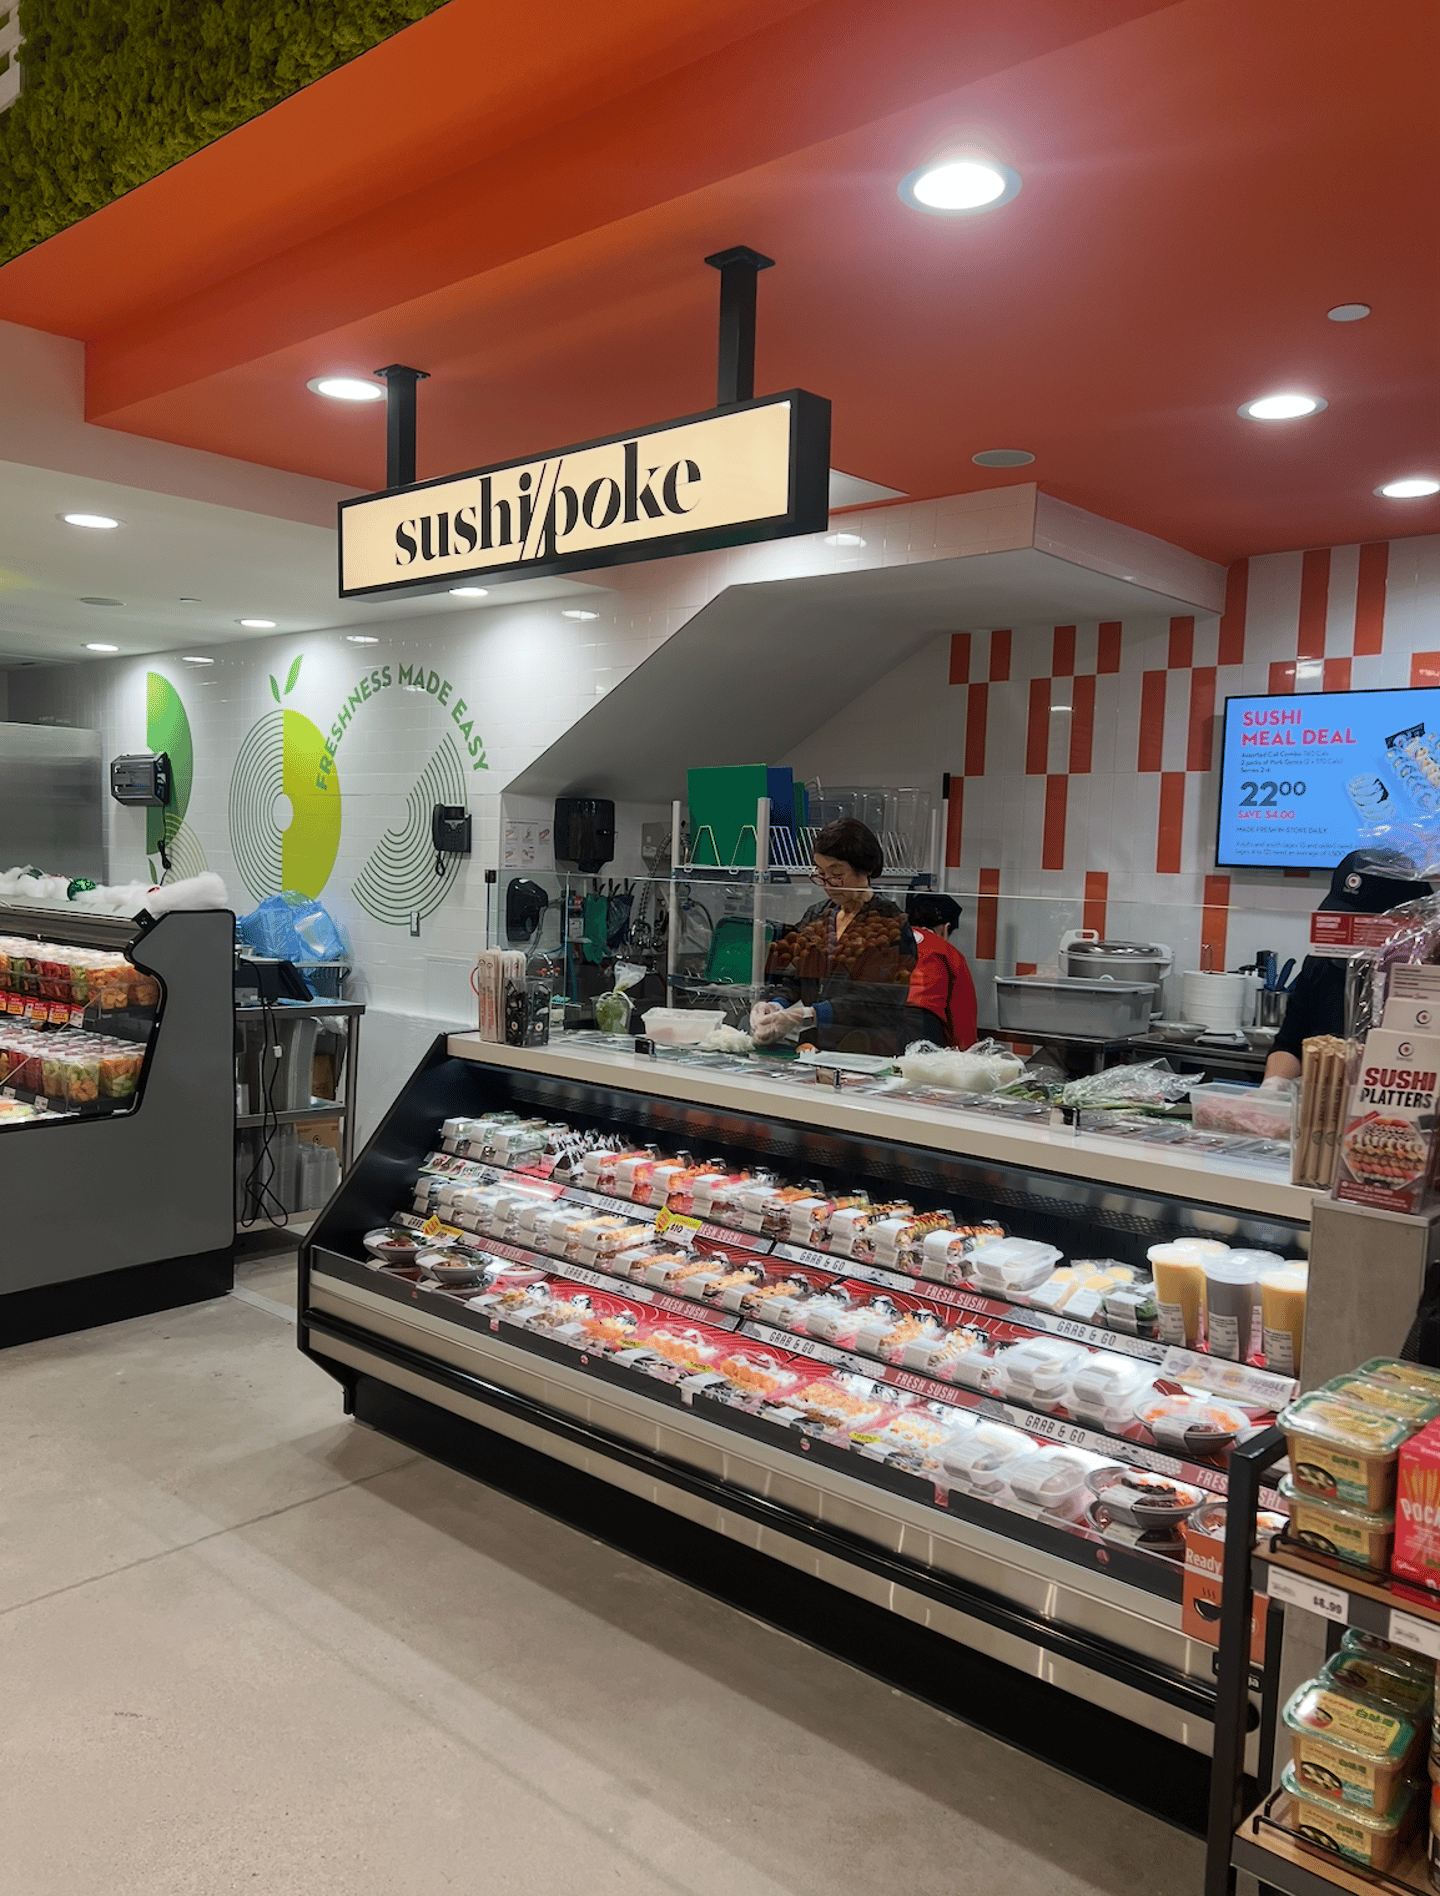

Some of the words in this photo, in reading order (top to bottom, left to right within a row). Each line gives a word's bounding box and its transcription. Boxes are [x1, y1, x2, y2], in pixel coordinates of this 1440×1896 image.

[316, 666, 392, 791] FRESHNESS
[398, 663, 453, 706] MADE
[451, 698, 489, 770] EASY
[1243, 709, 1302, 726] SUSHI
[1241, 730, 1296, 746] MEAL
[1302, 728, 1356, 745] DEAL
[1237, 810, 1262, 820] SAVE
[1265, 810, 1296, 820] $4.00
[1364, 1066, 1437, 1092] SUSHI
[1359, 1087, 1434, 1109] PLATTERS
[598, 1197, 617, 1209] GRAB
[485, 1240, 503, 1253] FRESH
[718, 1229, 743, 1244] SUSHI
[800, 1251, 821, 1264] GRAB
[823, 1257, 831, 1267] &
[833, 1259, 846, 1271] GO
[564, 1265, 582, 1279] GRAB
[592, 1272, 601, 1285] GO
[660, 1296, 681, 1311] FRESH
[682, 1303, 709, 1320] SUSHI
[925, 1285, 955, 1306] FRESH
[957, 1293, 988, 1311] SUSHI
[769, 1331, 791, 1345] GRAB
[793, 1337, 800, 1346] &
[802, 1340, 815, 1355] GO
[1057, 1321, 1087, 1338] GRAB
[1089, 1328, 1098, 1339] &
[1101, 1331, 1117, 1346] GO
[895, 1372, 925, 1390] FRESH
[926, 1381, 959, 1402] SUSHI
[1025, 1414, 1055, 1432] GRAB
[1058, 1424, 1066, 1436] &
[1069, 1427, 1086, 1443] GO
[1196, 1470, 1229, 1494] FRES
[1185, 1547, 1222, 1575] Ready
